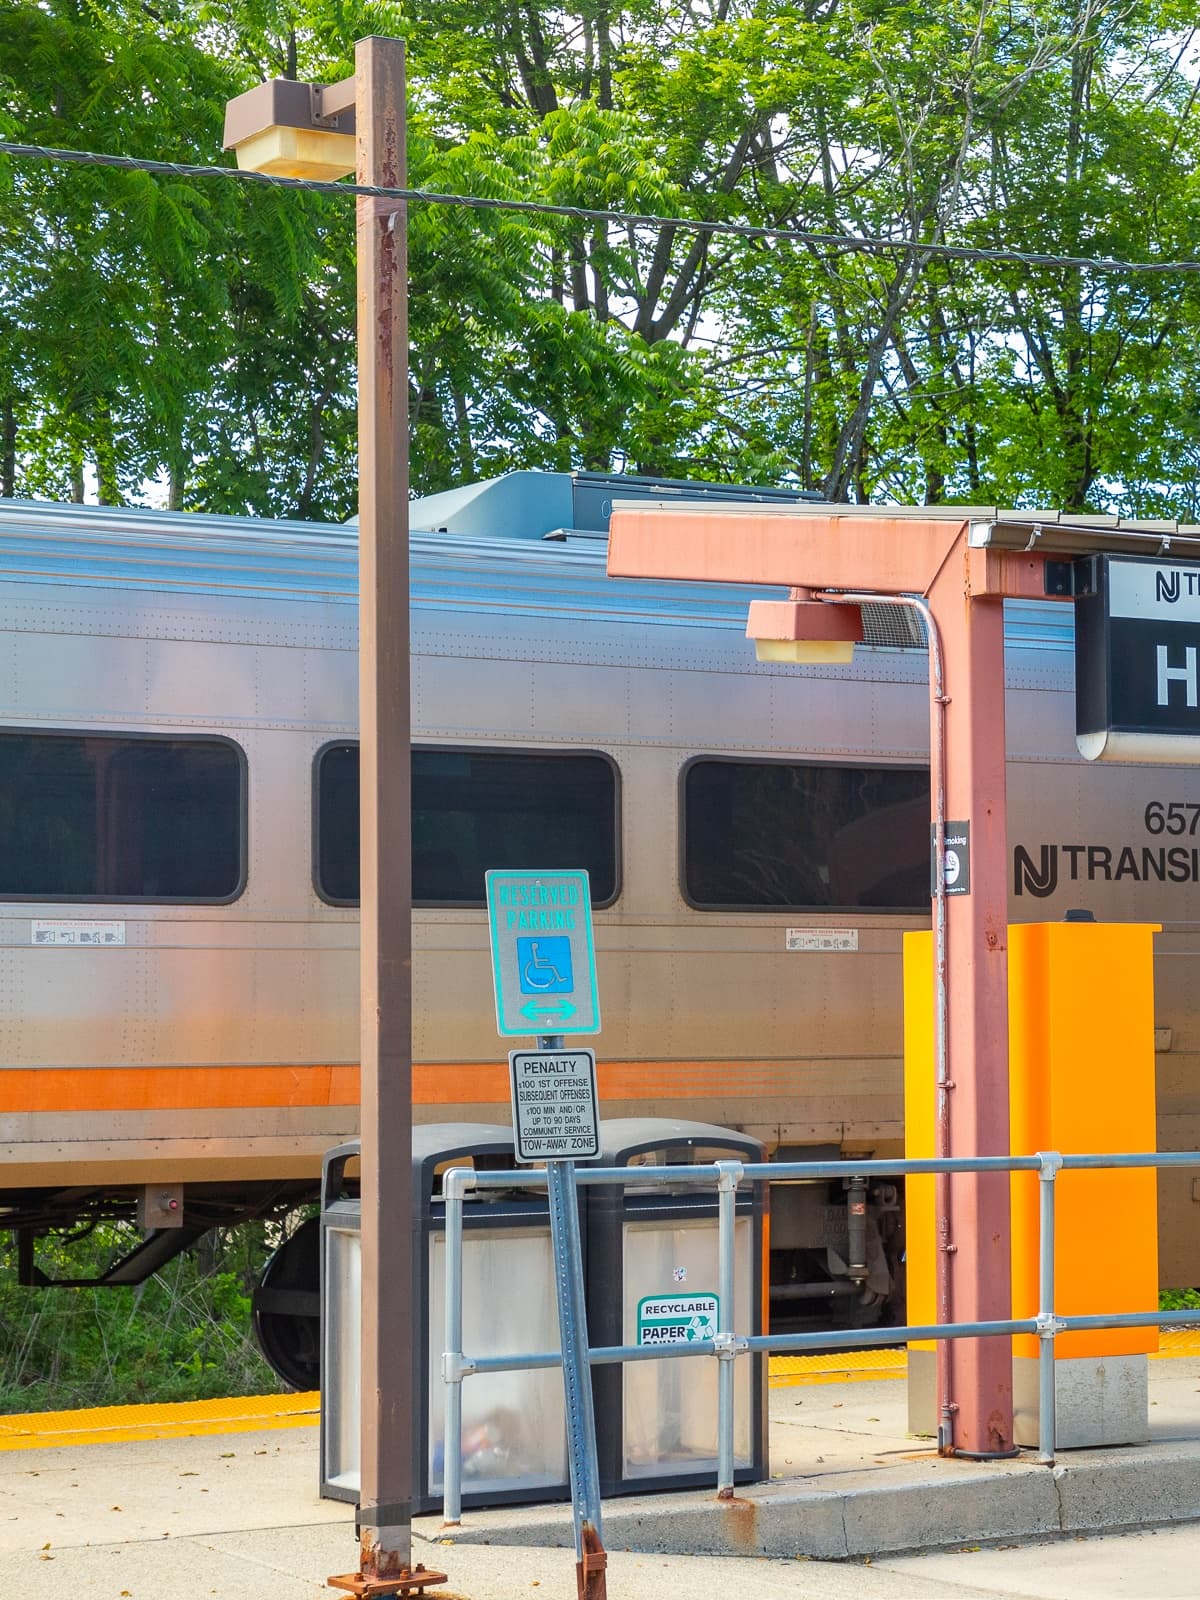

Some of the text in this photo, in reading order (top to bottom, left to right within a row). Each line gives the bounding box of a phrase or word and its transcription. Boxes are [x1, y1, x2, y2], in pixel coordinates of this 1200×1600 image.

[1156, 571, 1180, 603] NJ
[1014, 844, 1058, 898] NJ
[499, 884, 579, 906] RESERVED
[507, 909, 576, 930] PARKING
[524, 1060, 577, 1074] PENALTY
[518, 1078, 589, 1089] $100 1ST OFFENSE
[520, 1088, 591, 1102] SUBSEQUENT OFFENSES
[543, 1106, 555, 1114] MIN
[532, 1115, 581, 1125] UP TO 90 DAYS
[523, 1125, 592, 1136] COMMUNITY SERVICE
[523, 1137, 595, 1151] TOW-AWAY ZONE
[645, 1302, 715, 1315] RECYCLABLE
[642, 1326, 686, 1339] PAPER
